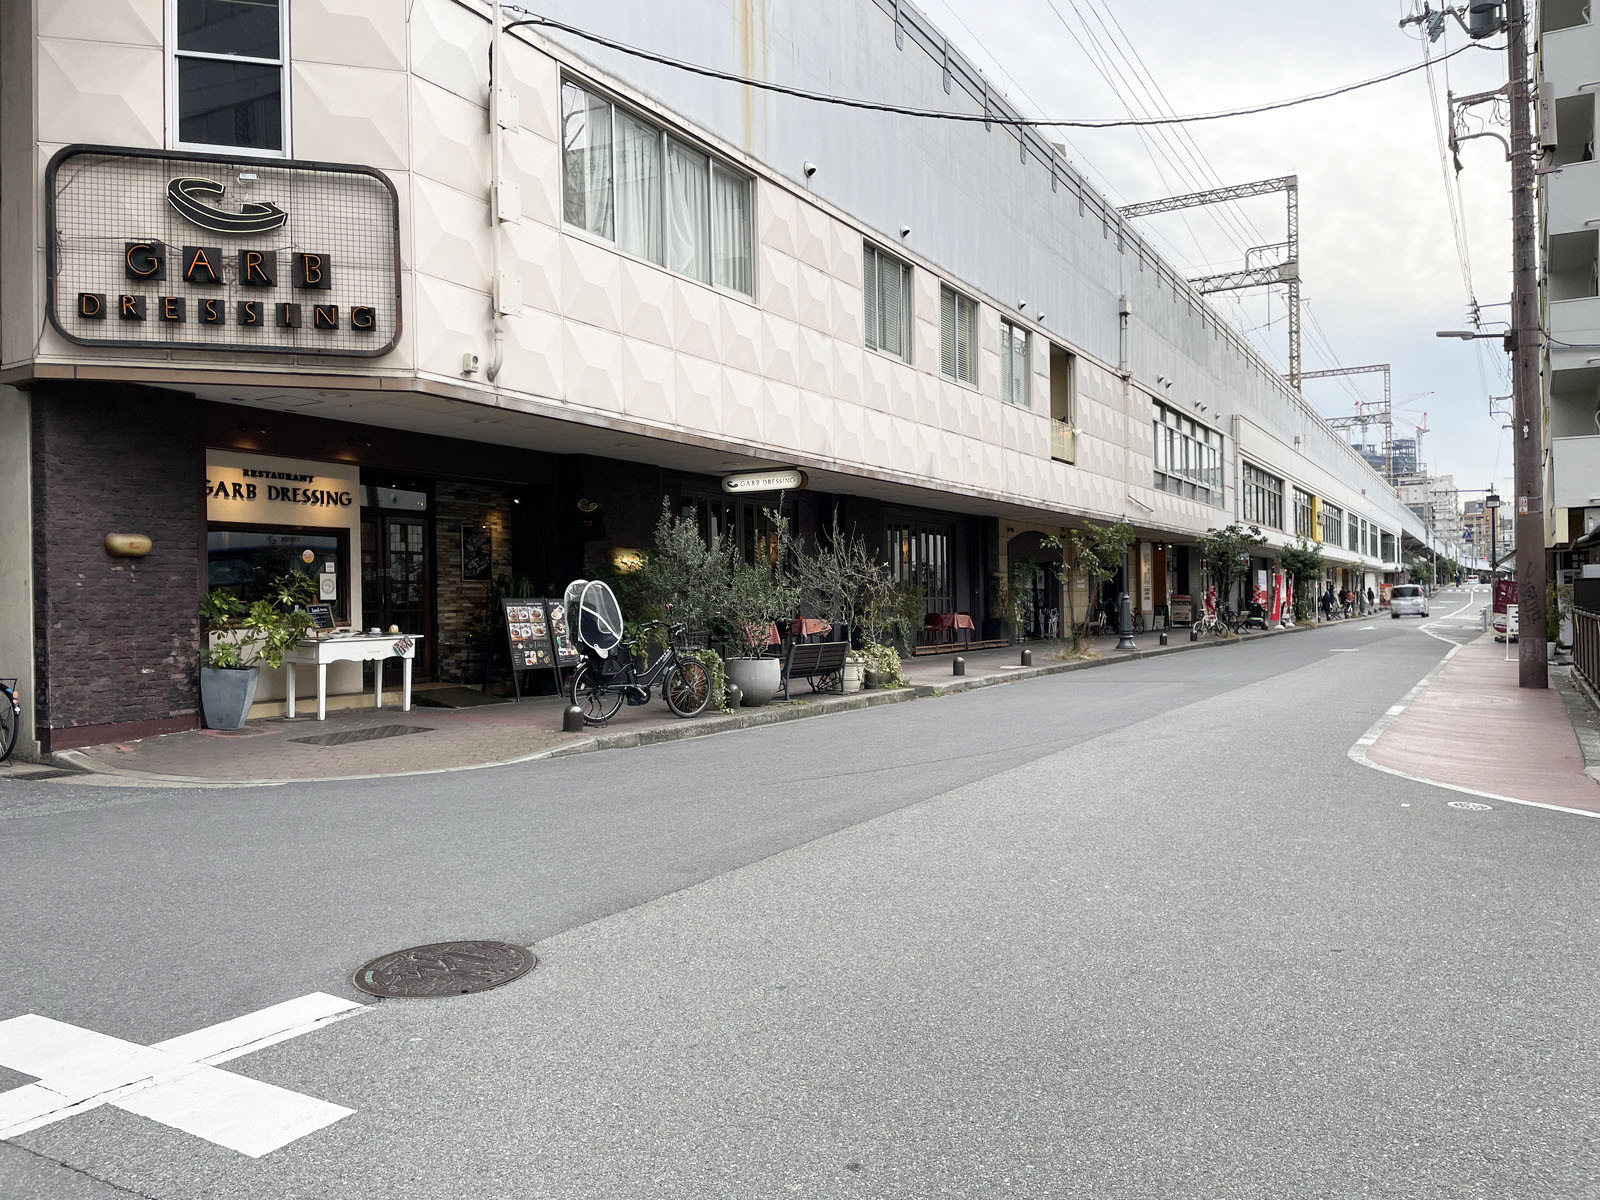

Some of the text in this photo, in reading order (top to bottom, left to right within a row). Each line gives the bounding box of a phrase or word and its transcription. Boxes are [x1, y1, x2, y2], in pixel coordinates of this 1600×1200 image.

[126, 243, 327, 287] GARB
[80, 293, 375, 329] DRESSING
[242, 468, 315, 483] RESTAURANT
[740, 476, 796, 487] GARB DRESSING
[267, 485, 352, 506] DRESSING
